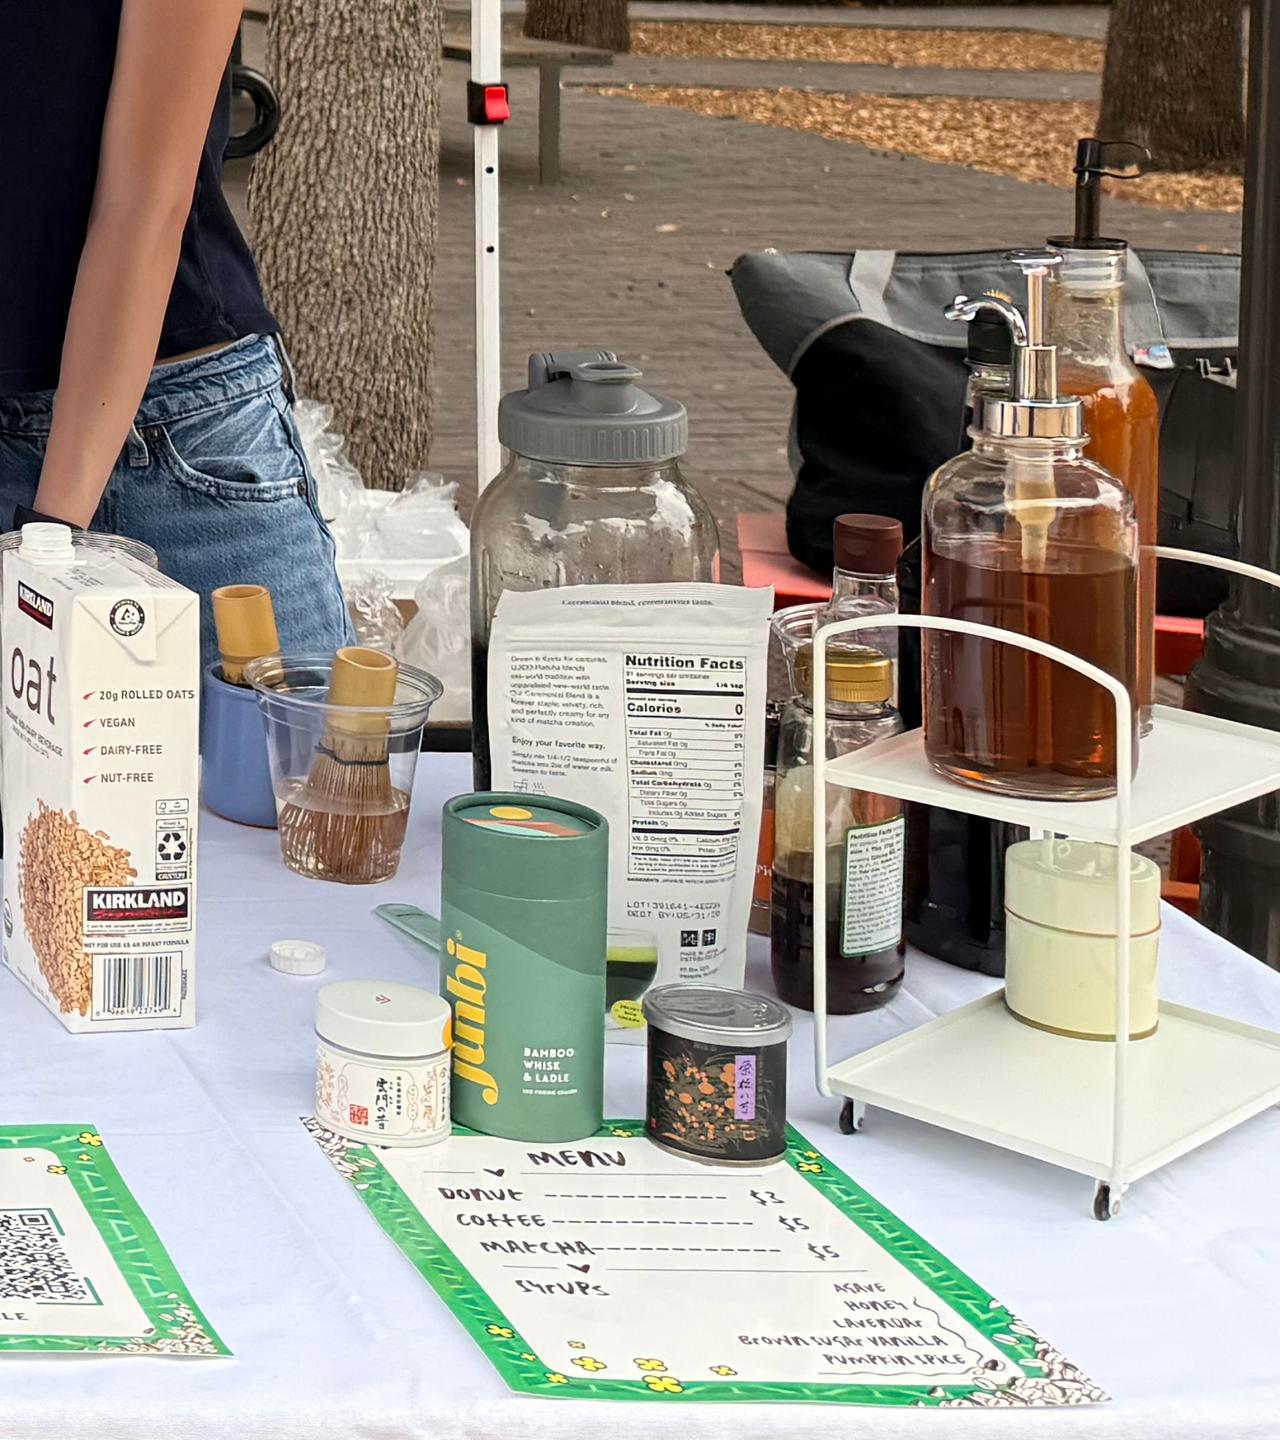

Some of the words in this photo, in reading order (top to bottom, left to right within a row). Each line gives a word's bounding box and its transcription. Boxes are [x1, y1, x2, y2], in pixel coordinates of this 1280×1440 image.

[625, 655, 695, 668] Nutrition
[700, 658, 744, 670] Facts
[11, 647, 57, 726] oat
[99, 691, 118, 701] 20g
[121, 690, 163, 699] ROLLED
[166, 690, 195, 699] OATS
[627, 702, 681, 713] Calories
[735, 704, 743, 715] 0
[99, 717, 136, 728] VEGAN
[512, 736, 533, 746] Enjoy
[555, 740, 585, 748] favorite
[100, 745, 163, 755] DAIRY-FREE
[100, 772, 154, 783] NUT-FREE
[92, 891, 186, 909] KIRKLAND
[524, 1047, 575, 1058] BAMBOO
[523, 1060, 560, 1070] WHISK
[523, 1072, 531, 1081] &
[535, 1073, 569, 1082] LADLE
[778, 1215, 810, 1232] $5
[807, 1243, 840, 1261] $5
[834, 1282, 886, 1294] AGAVE
